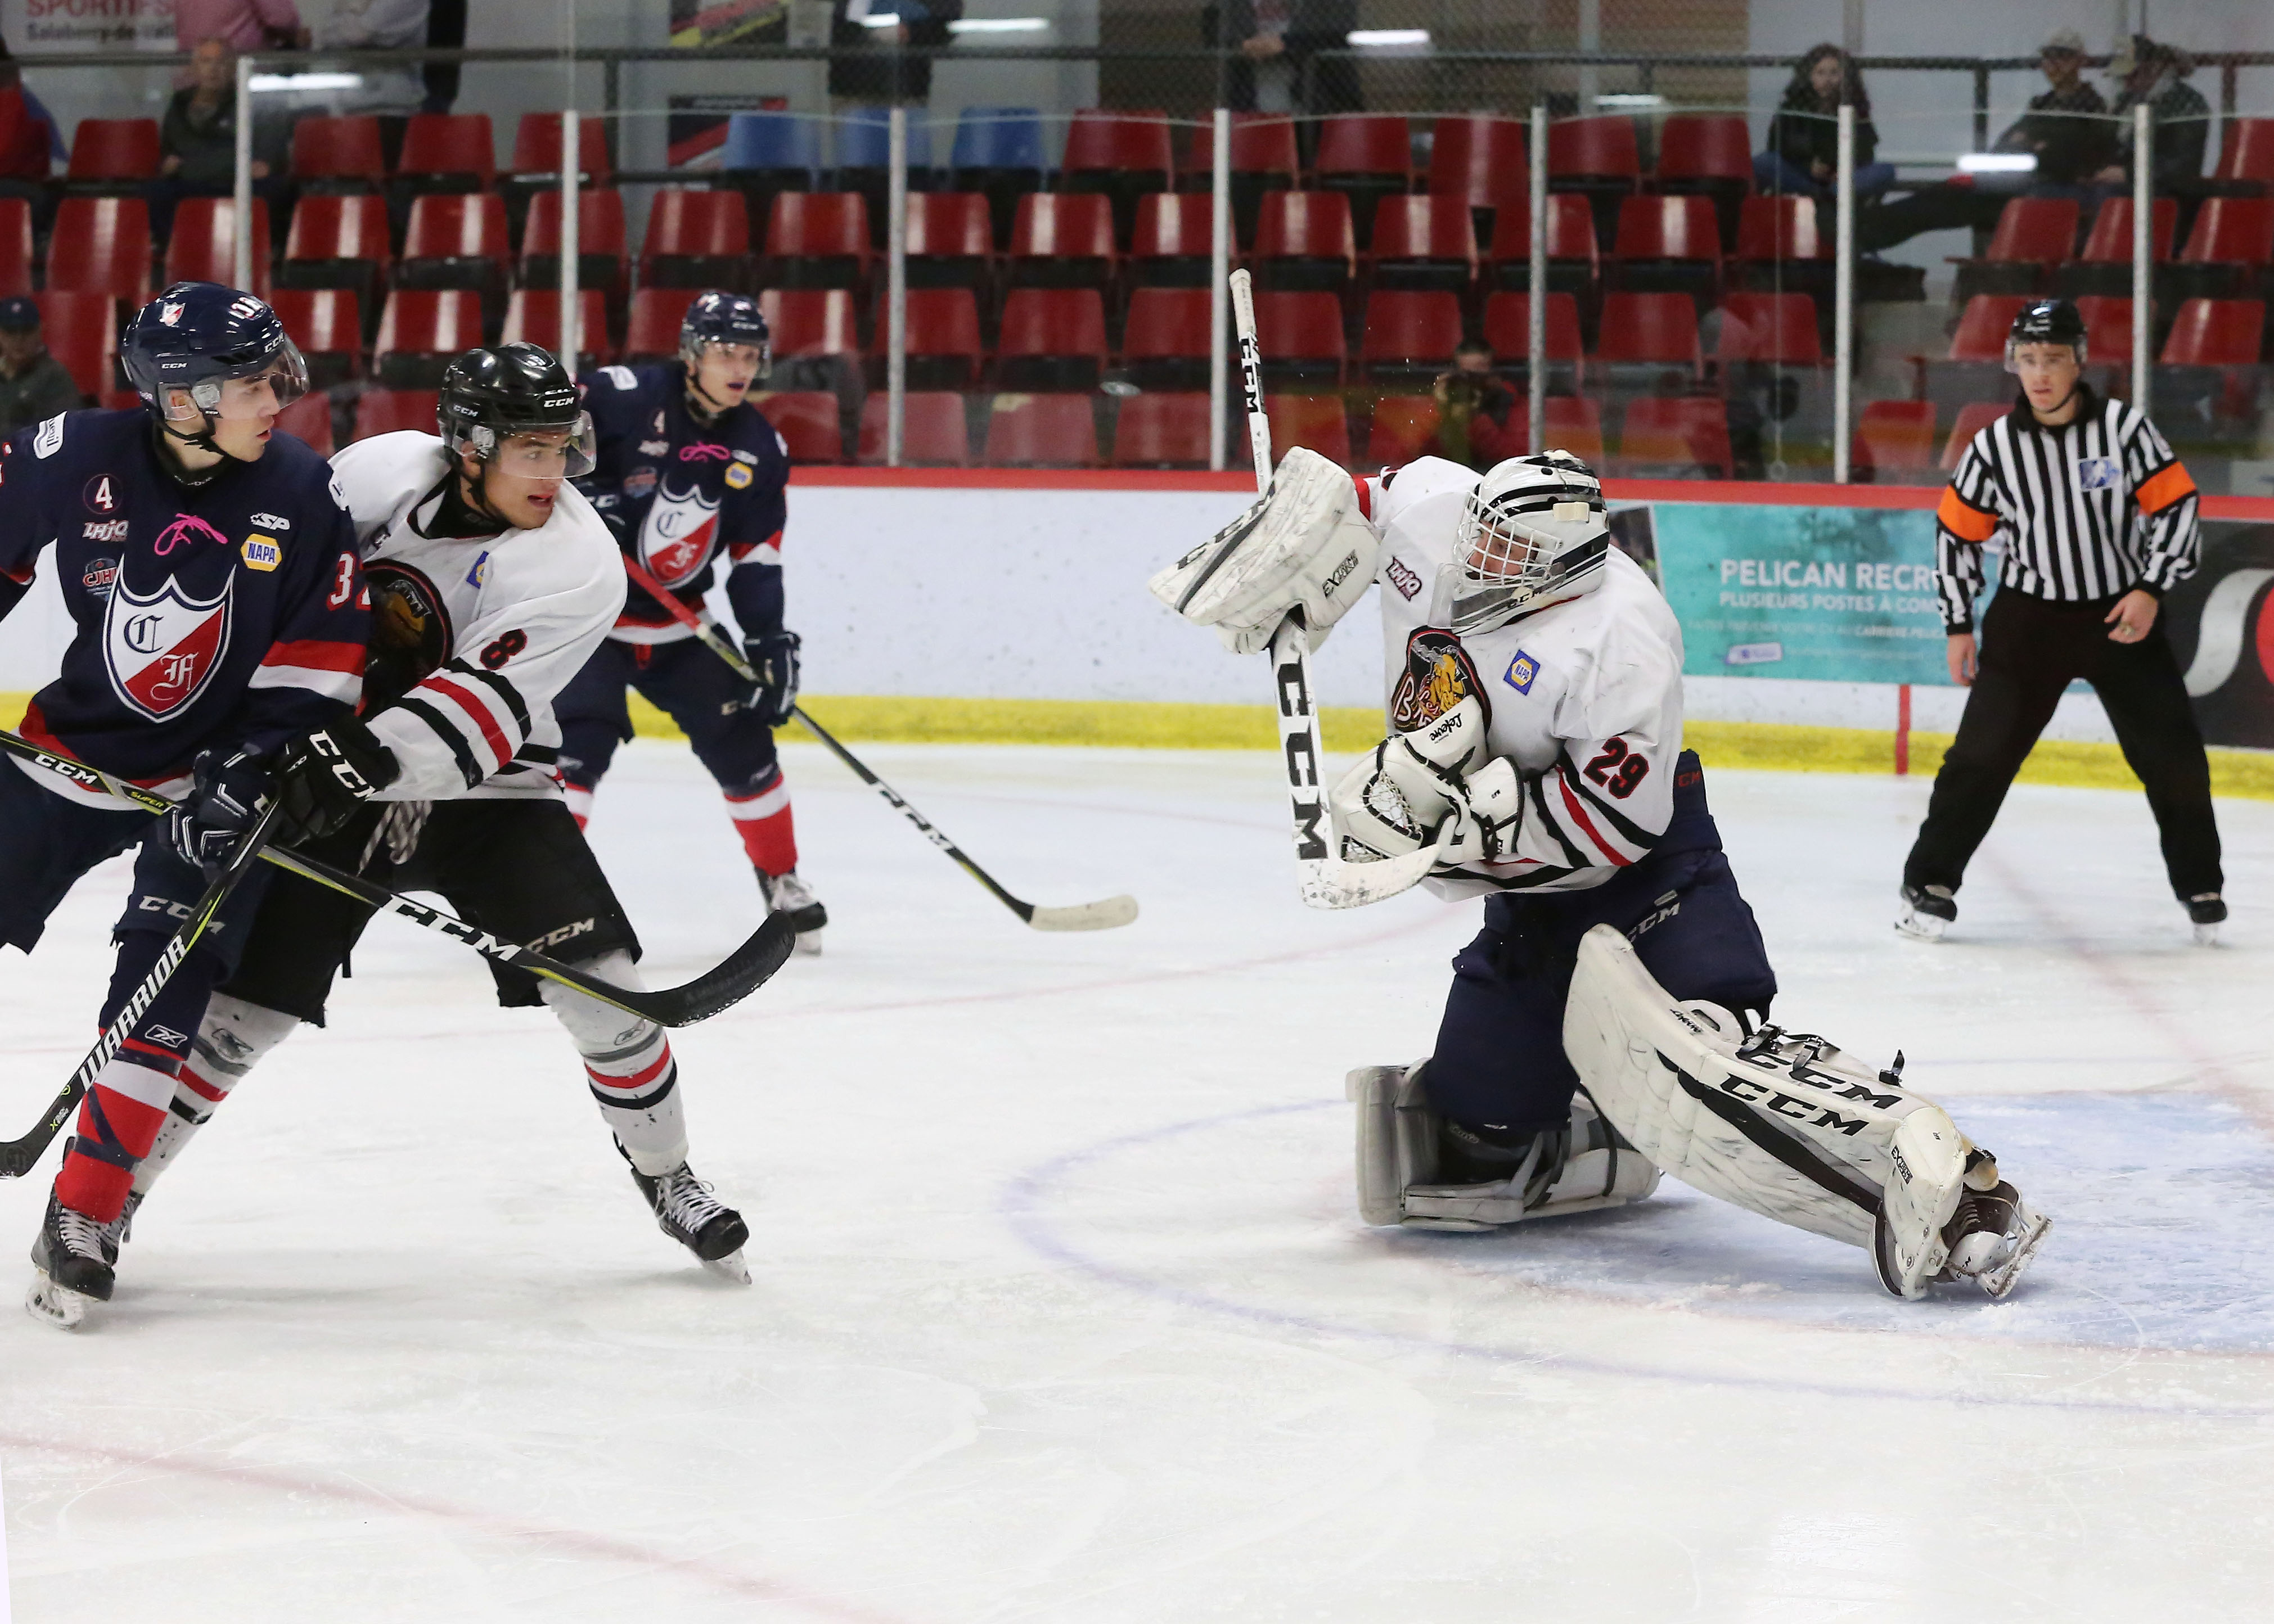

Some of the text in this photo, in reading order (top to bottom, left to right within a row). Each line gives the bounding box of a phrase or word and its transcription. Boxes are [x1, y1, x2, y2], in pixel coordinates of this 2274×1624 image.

[452, 403, 478, 417] CCM
[543, 396, 575, 408] CCM
[94, 476, 113, 510] 4
[247, 542, 276, 563] NAPA
[1720, 559, 1847, 589] PELICAN
[1719, 592, 1808, 609] PLUSIEURS
[1812, 593, 1875, 612] POSTES
[480, 628, 528, 671] 8
[34, 753, 98, 785] CCM
[1277, 653, 1329, 860] CCM
[1583, 736, 1650, 800] 29
[130, 791, 165, 809] SUPER
[382, 893, 523, 962] CCM
[525, 917, 595, 954] CCM
[78, 934, 187, 1092] WARRIOR
[1735, 1048, 1903, 1109] CCM
[1719, 1072, 1870, 1136] CCM
